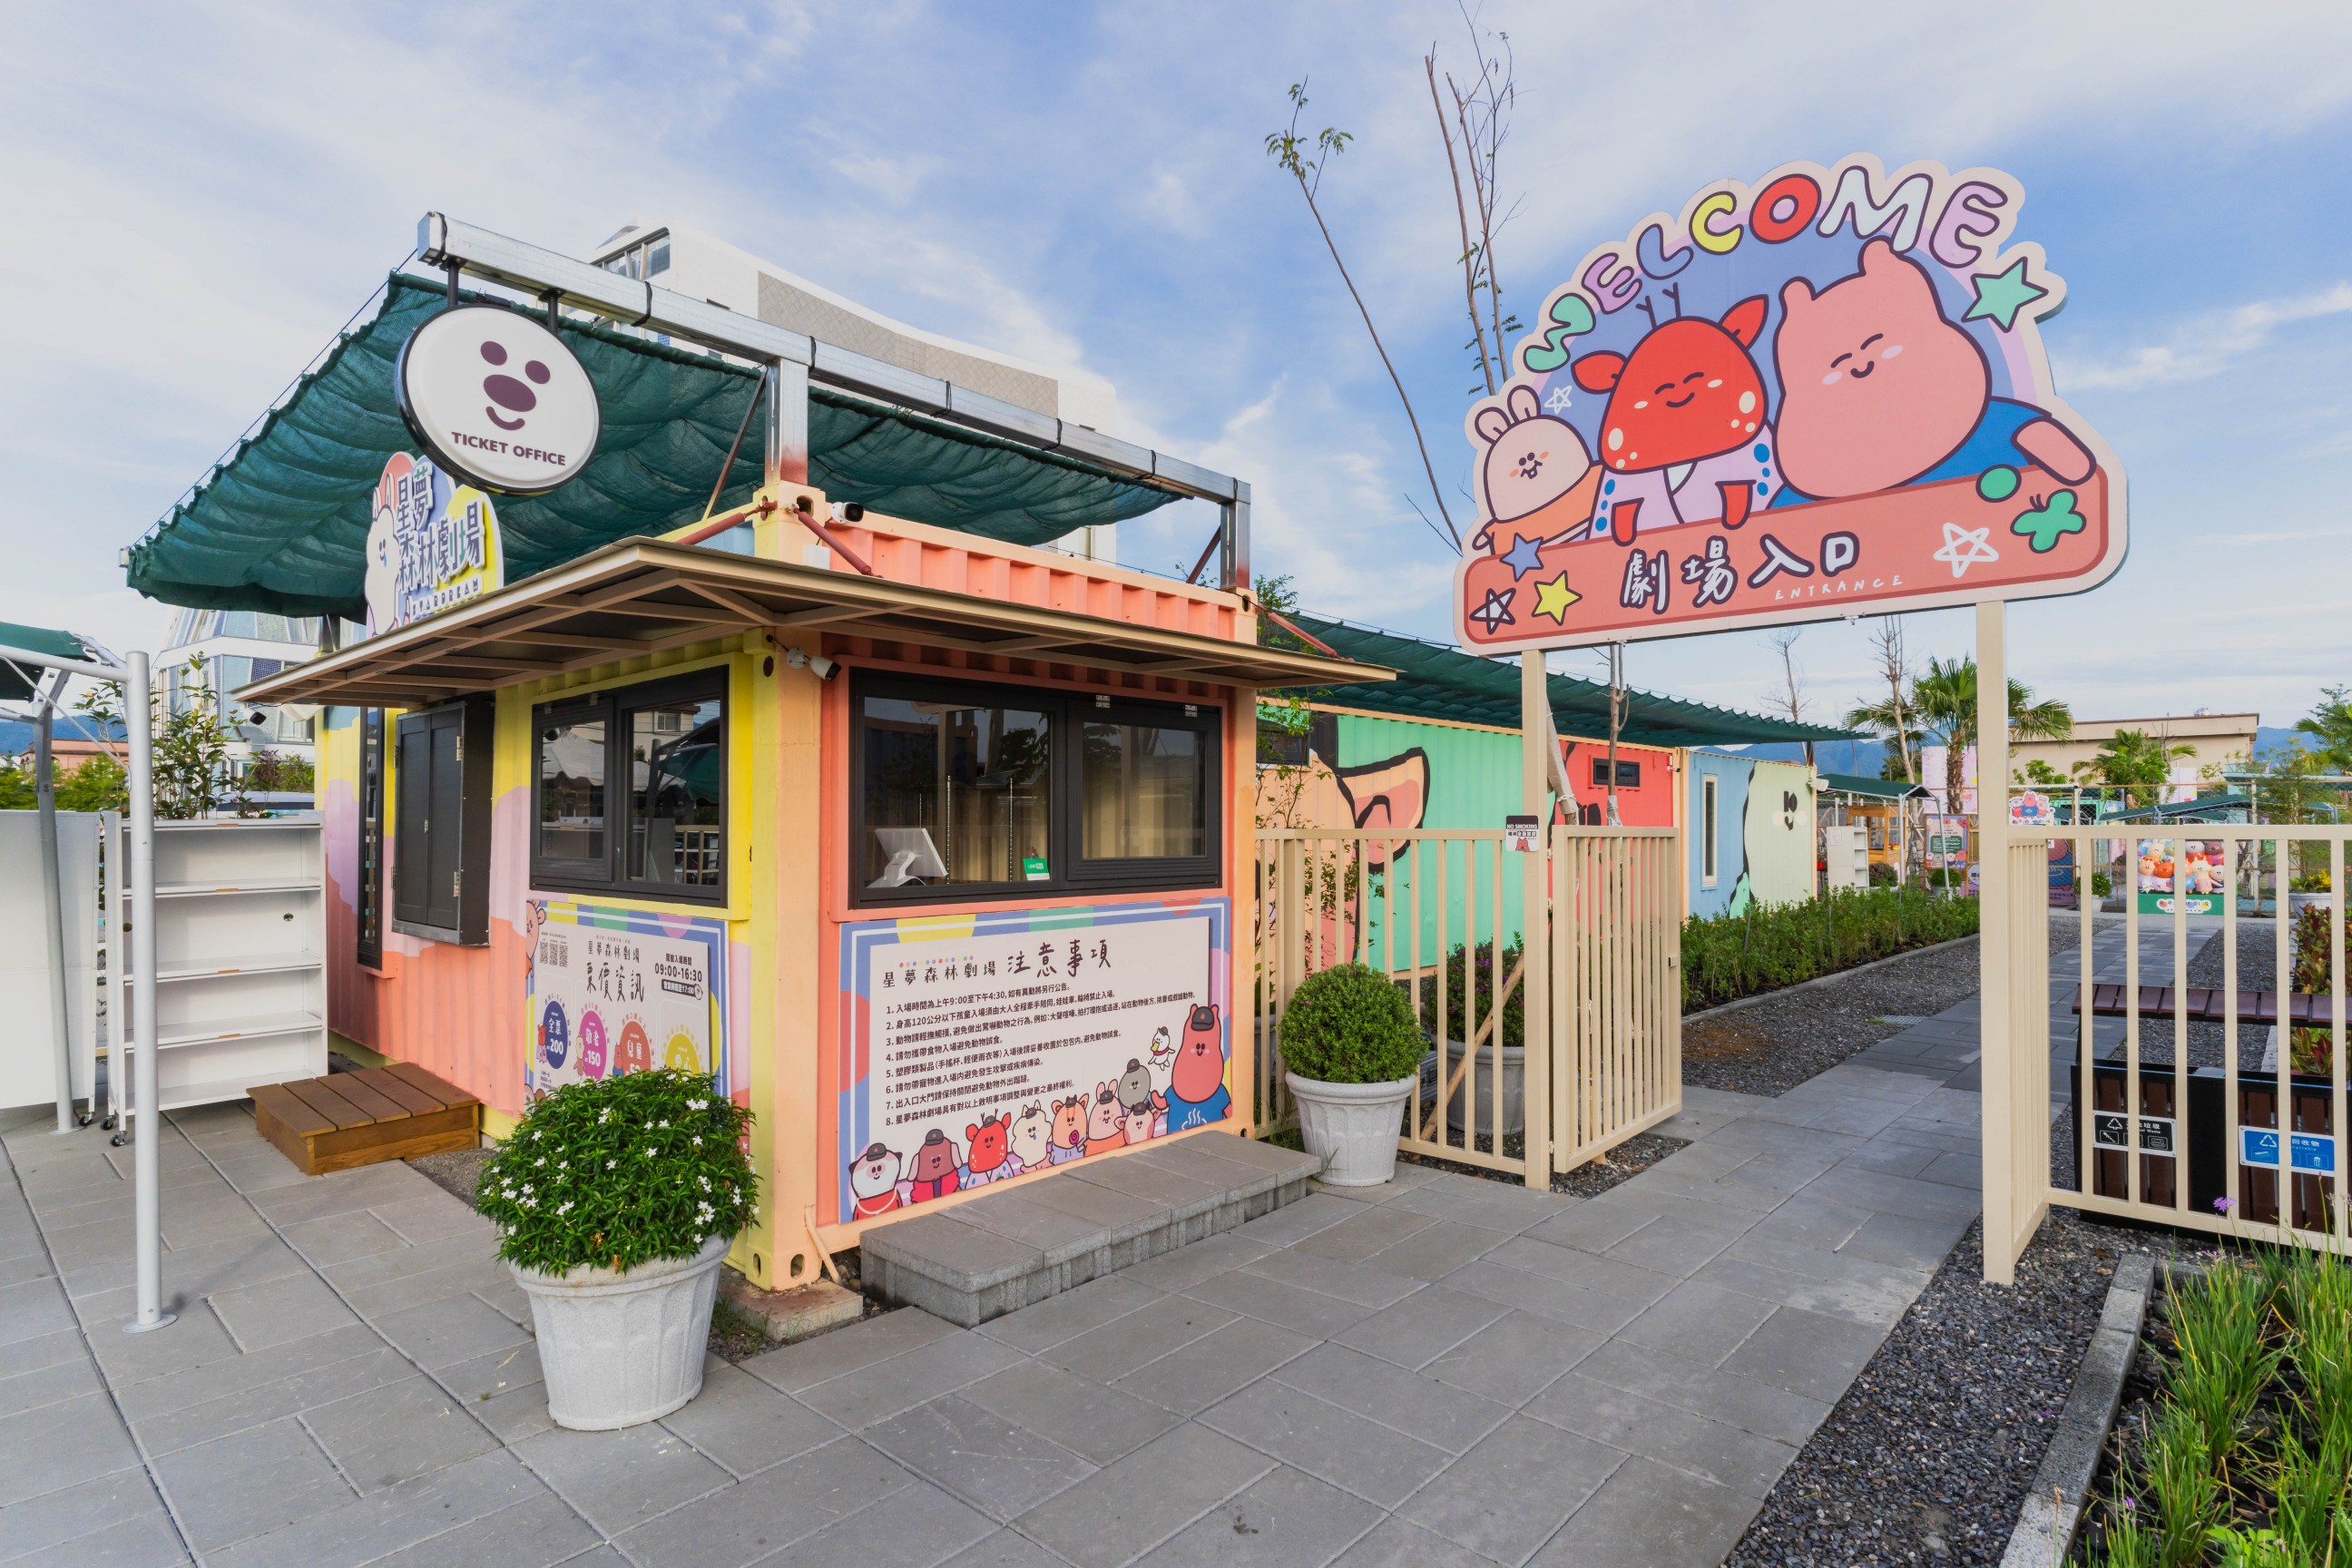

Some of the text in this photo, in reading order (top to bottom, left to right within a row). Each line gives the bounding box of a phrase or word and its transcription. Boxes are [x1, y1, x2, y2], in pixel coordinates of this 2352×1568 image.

[1524, 165, 2008, 373] WELCOME
[451, 431, 566, 466] TICKET OFFICE
[1621, 531, 1860, 614] 劇場入口
[1774, 573, 1906, 601] ENTRANCE
[411, 577, 479, 616] STARDREAM
[654, 963, 703, 983] 09:00-16:30
[883, 938, 1112, 988] 星夢森林劇場 注意事項
[548, 1017, 562, 1035] 全票
[2291, 1138, 2320, 1148] 回收物
